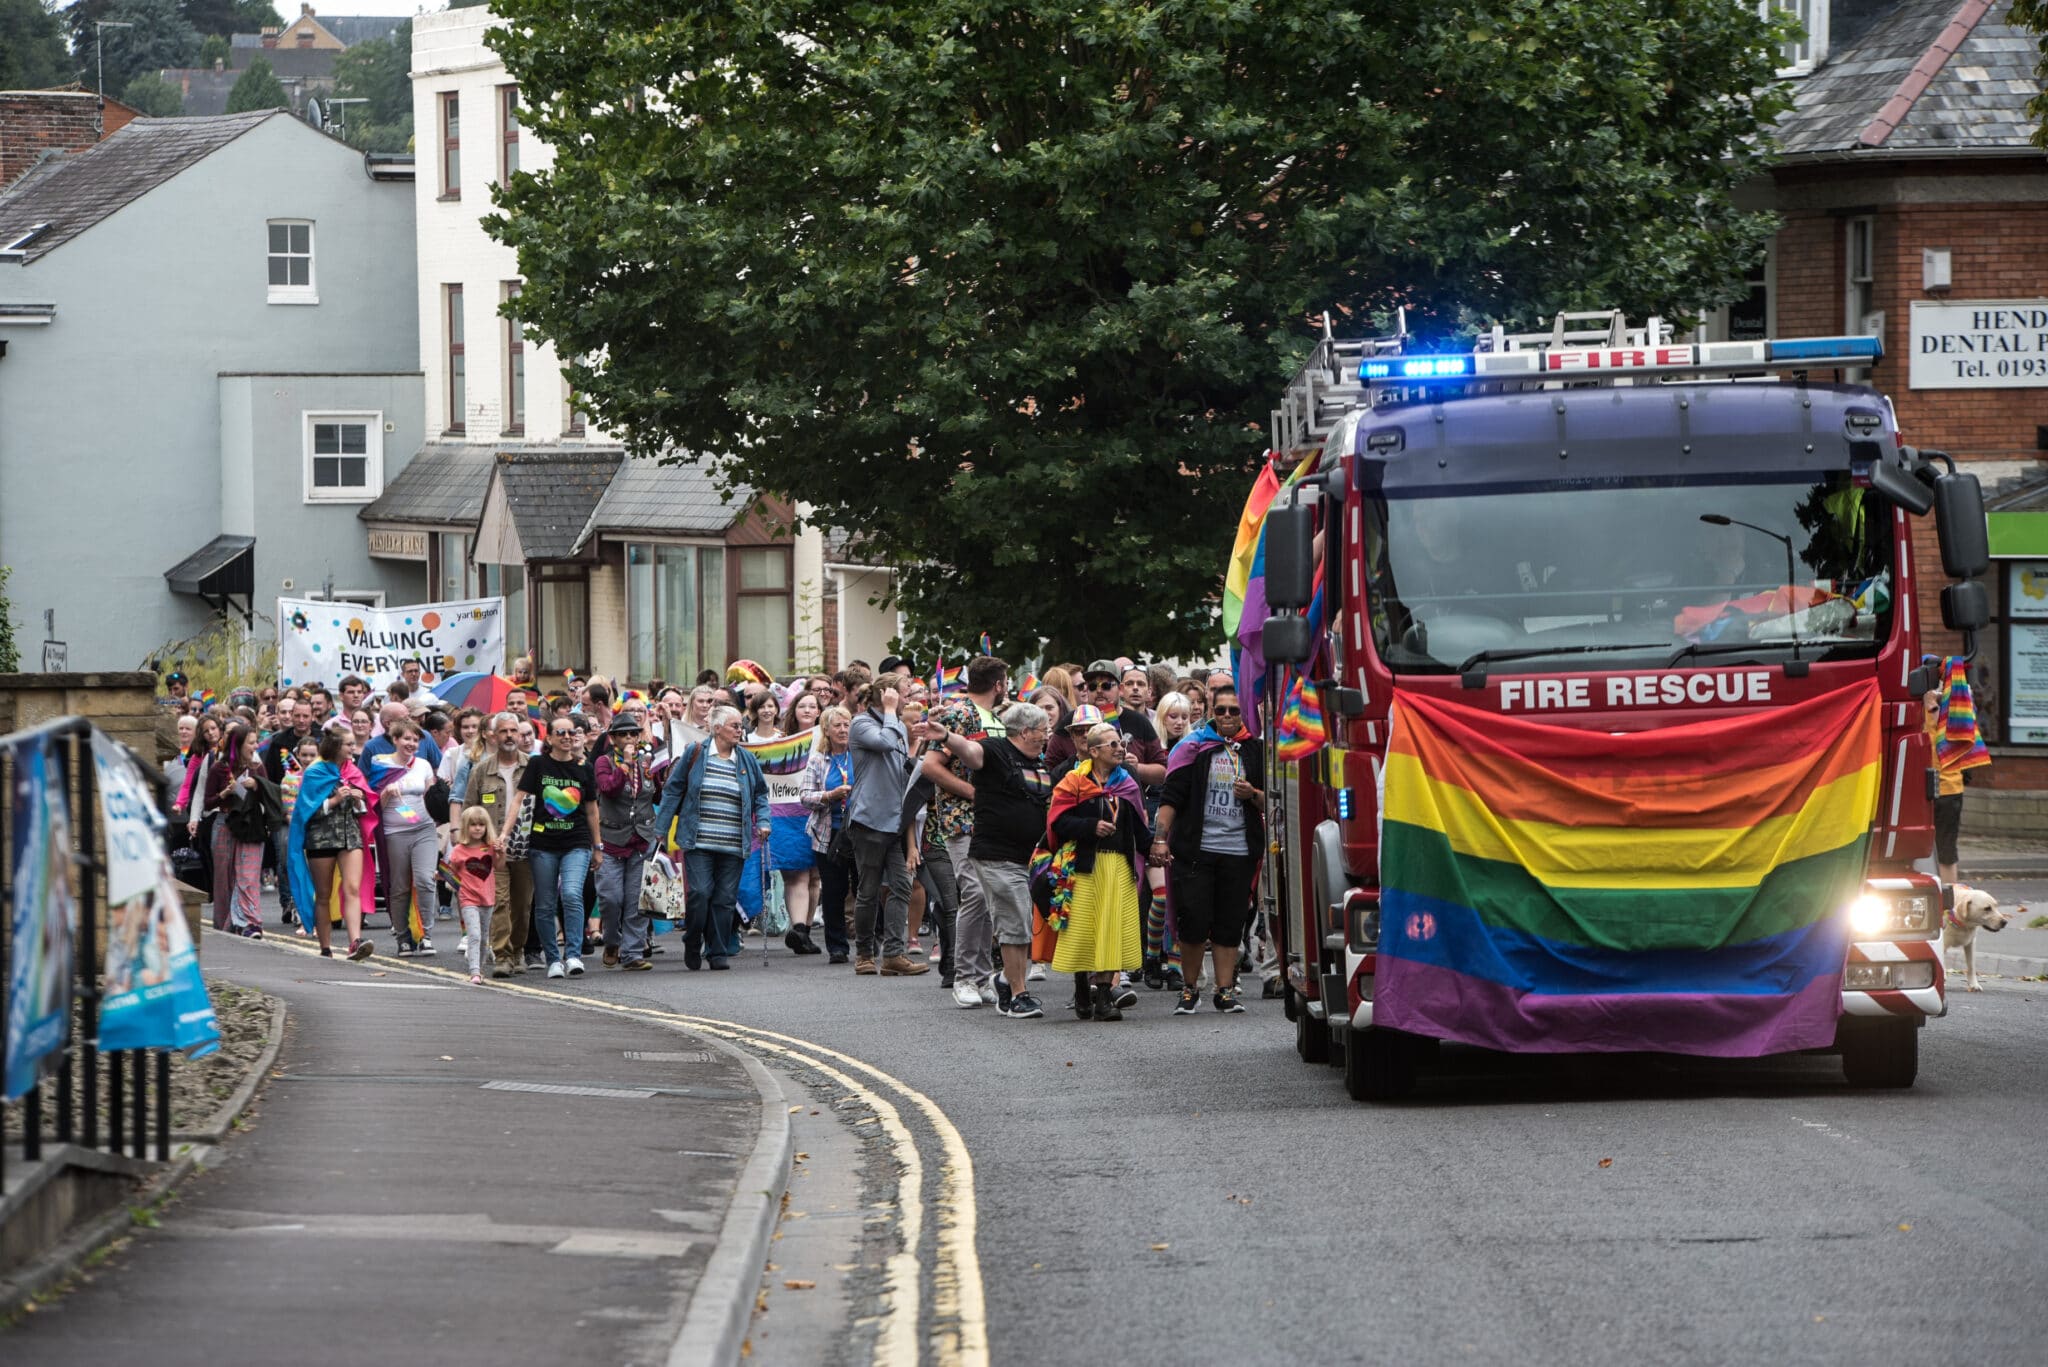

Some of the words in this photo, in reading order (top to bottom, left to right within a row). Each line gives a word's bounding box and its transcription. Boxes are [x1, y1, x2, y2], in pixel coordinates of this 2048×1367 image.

[1922, 334, 2029, 353] DENTAL
[1549, 348, 1690, 370] FIRE
[1952, 359, 1990, 377] Tel.
[346, 628, 434, 650] VALUING
[341, 652, 445, 674] EVERYNE
[1500, 679, 1590, 710] FIRE
[1606, 672, 1771, 706] RESCUE
[1210, 789, 1229, 806] TO
[1208, 805, 1227, 816] THIS
[1228, 808, 1238, 816] IS
